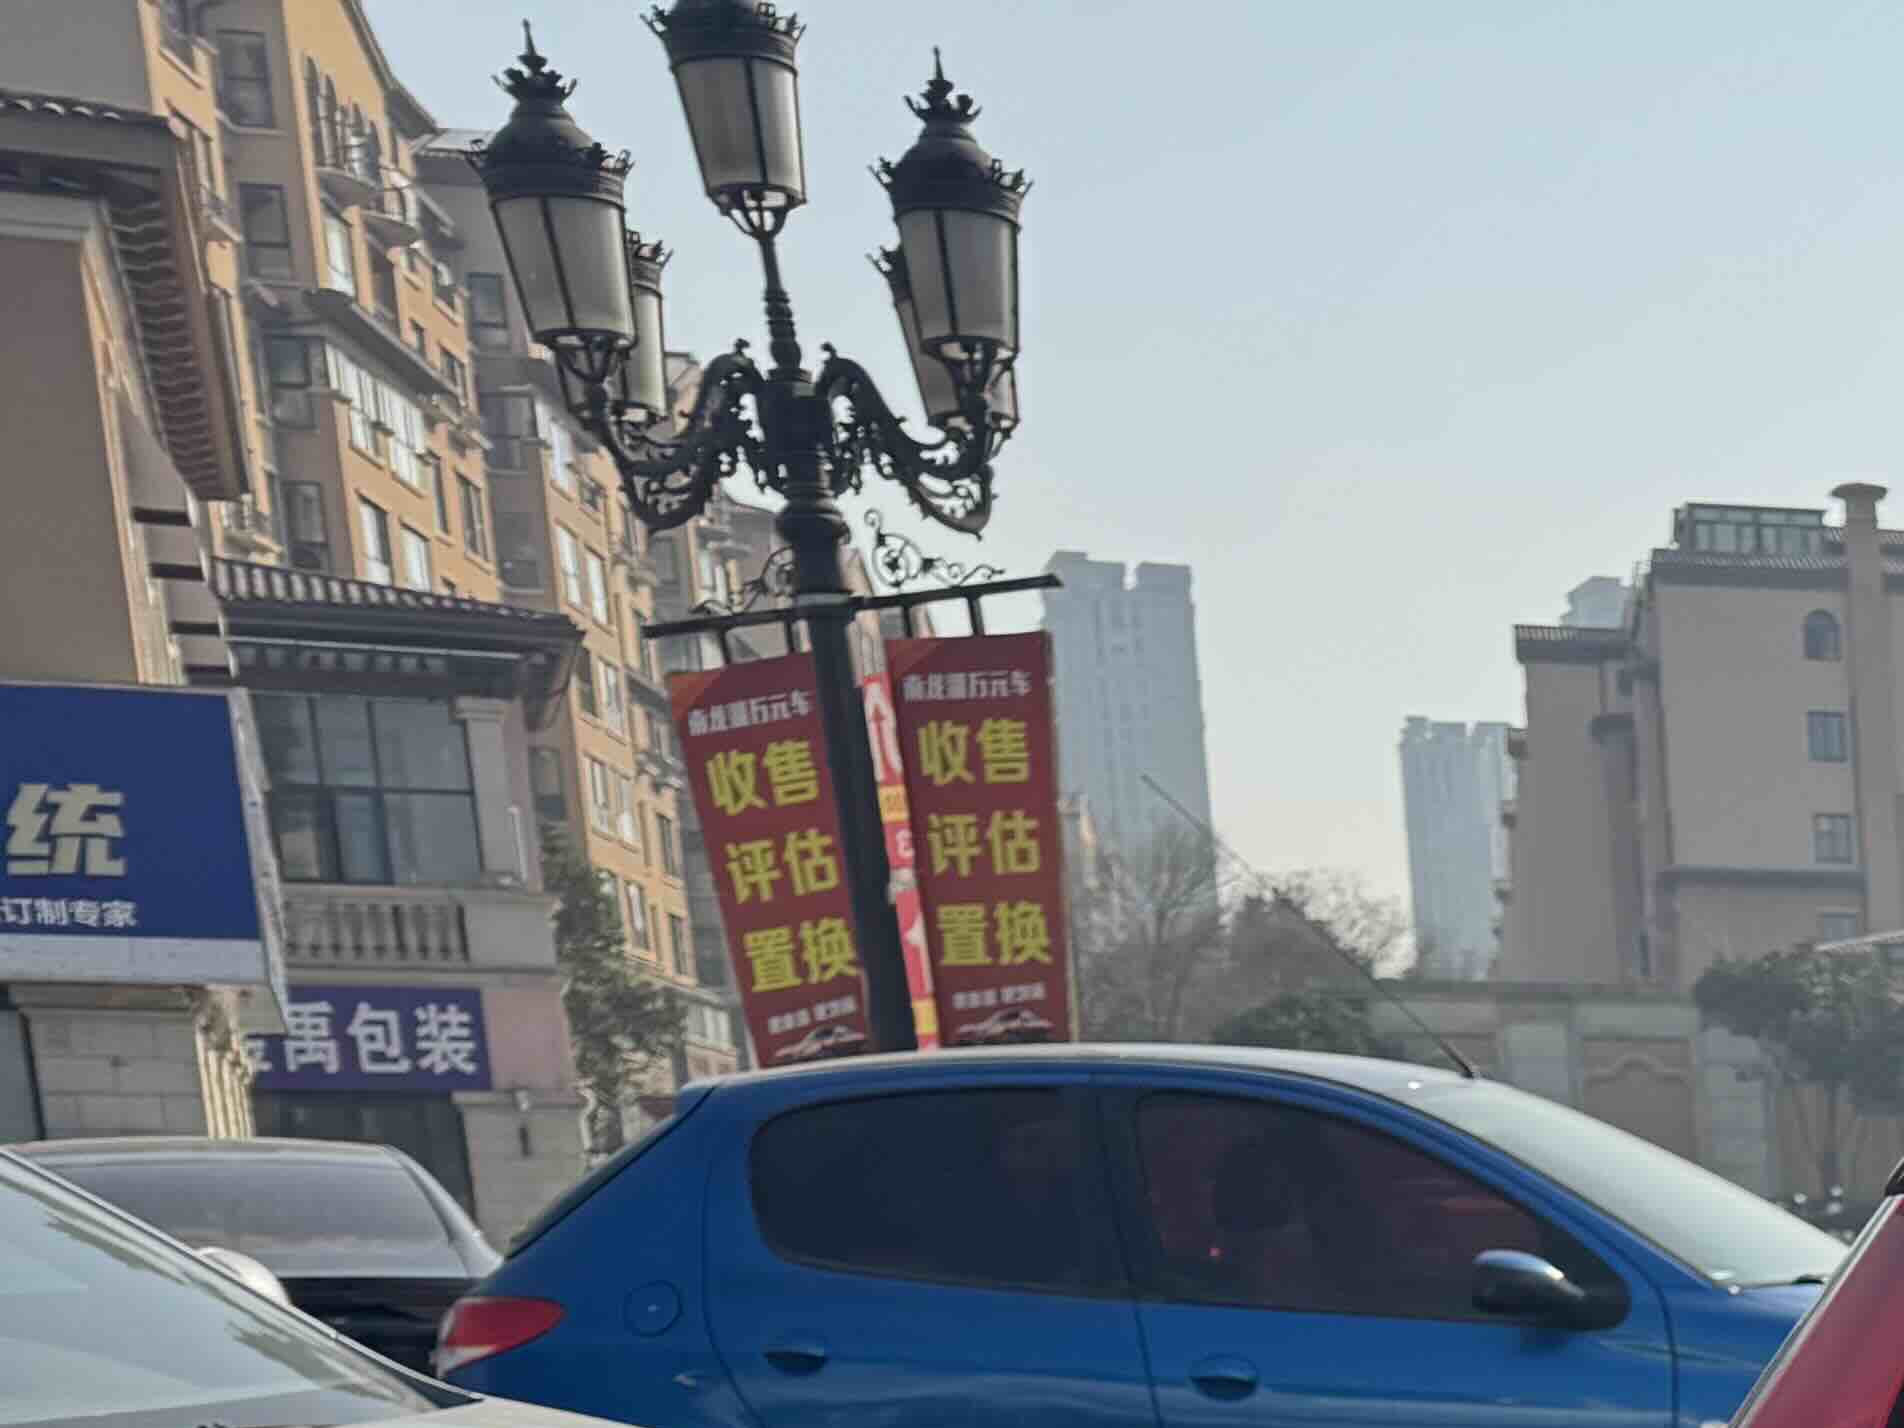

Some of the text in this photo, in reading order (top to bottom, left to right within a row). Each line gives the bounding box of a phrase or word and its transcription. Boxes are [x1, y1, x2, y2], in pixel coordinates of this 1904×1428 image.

[704, 738, 821, 817] 收售
[916, 717, 1032, 786] 收售
[6, 783, 127, 877] 统
[724, 827, 841, 905] 评估
[926, 808, 1042, 877] 评估
[0, 897, 139, 928] 订制专家
[936, 899, 1054, 967] 置换
[742, 916, 864, 993] 置换
